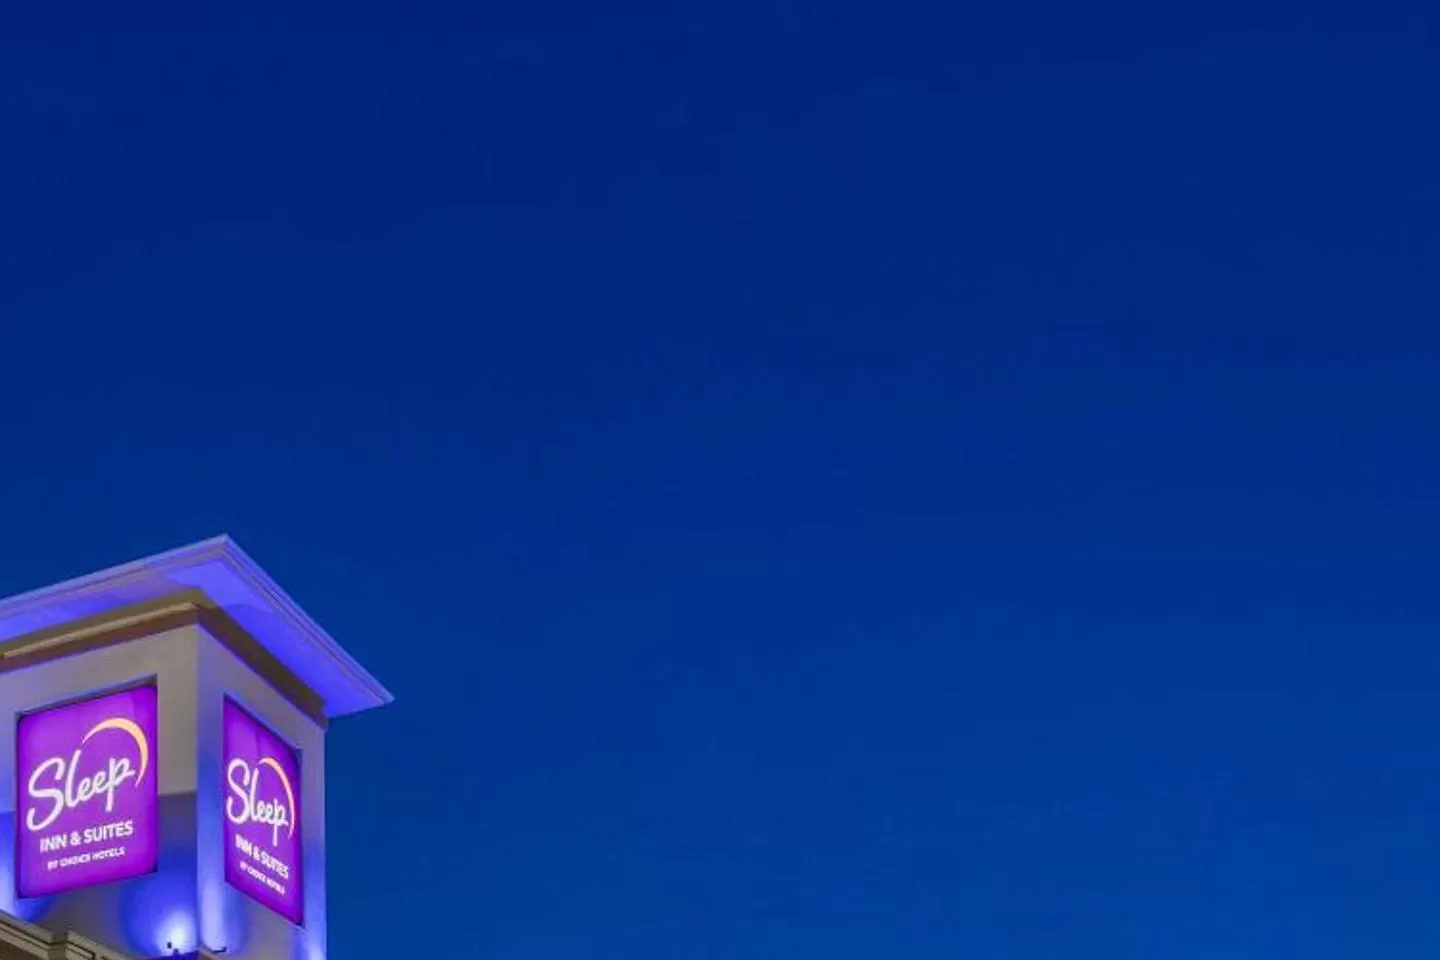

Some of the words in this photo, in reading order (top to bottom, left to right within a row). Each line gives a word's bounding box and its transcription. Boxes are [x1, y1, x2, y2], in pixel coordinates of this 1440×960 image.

[26, 749, 135, 831] Sleep
[226, 758, 288, 847] Sleep
[40, 834, 67, 853] INN
[70, 831, 81, 846] &
[83, 820, 134, 844] SUITES
